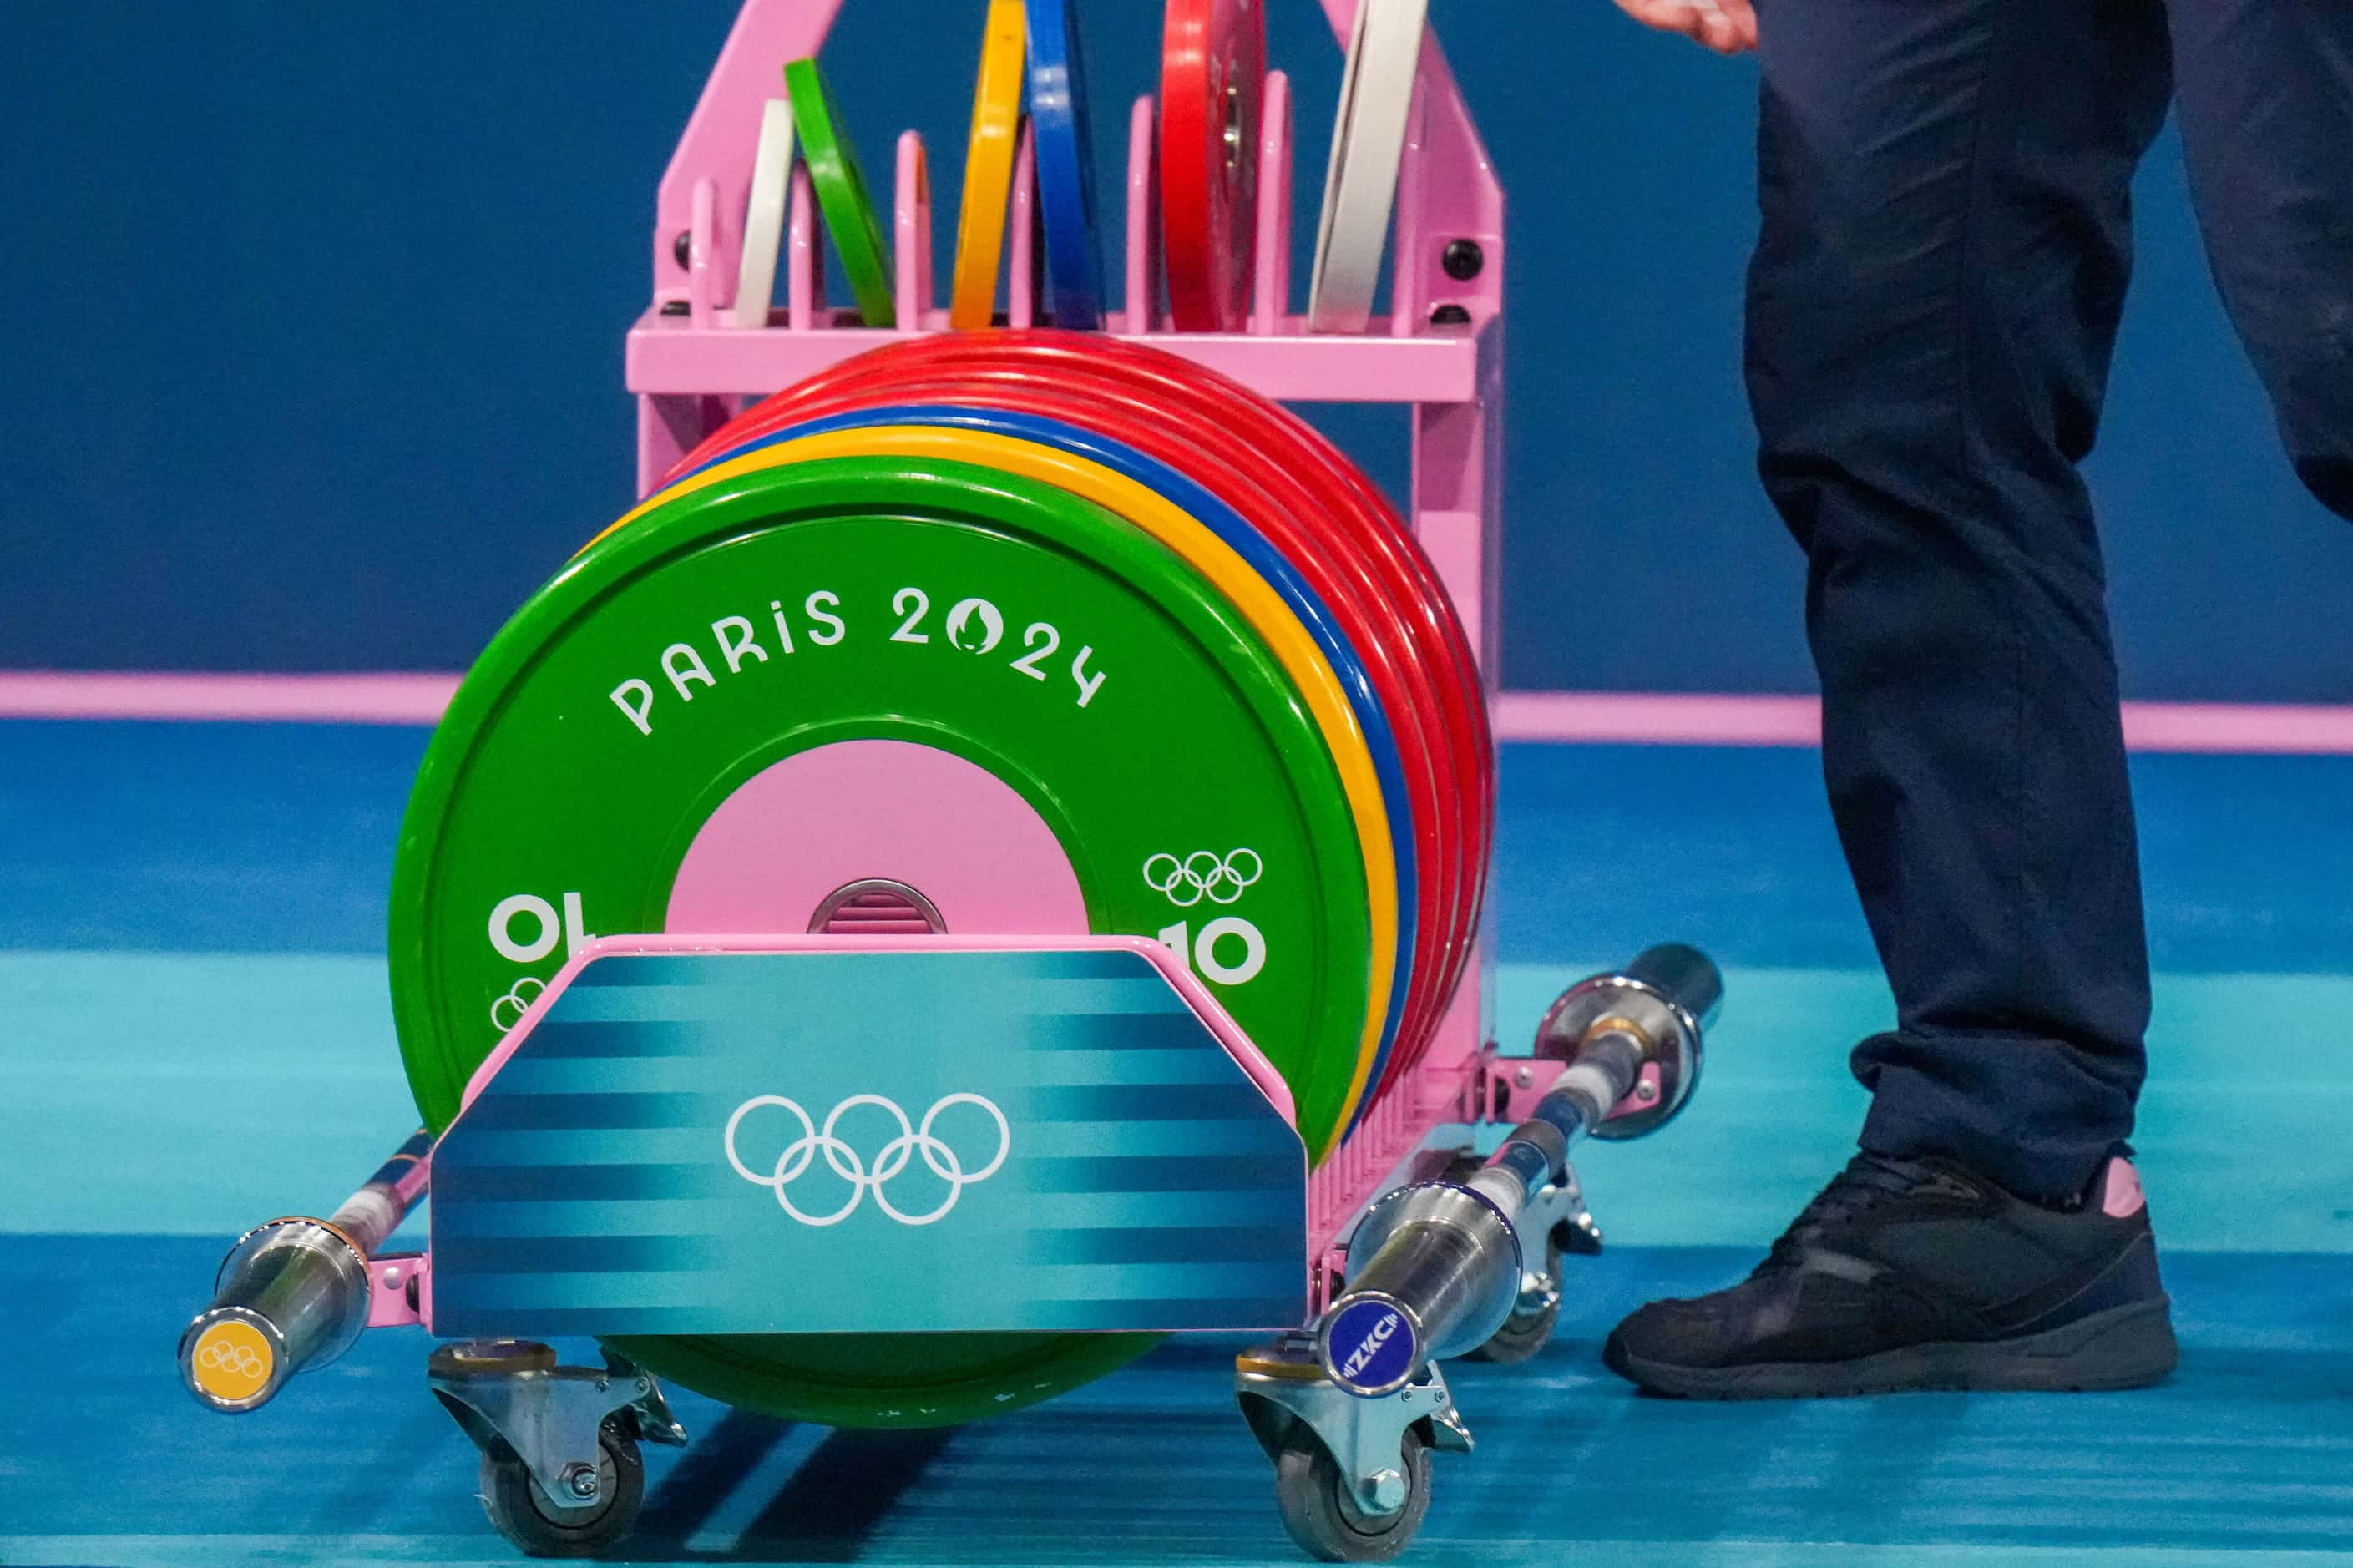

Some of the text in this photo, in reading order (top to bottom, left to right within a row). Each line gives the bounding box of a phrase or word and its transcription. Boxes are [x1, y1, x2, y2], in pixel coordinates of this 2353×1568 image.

[889, 587, 1107, 709] 2024
[1158, 916, 1267, 985] 10
[1346, 1318, 1395, 1373] ZKC
